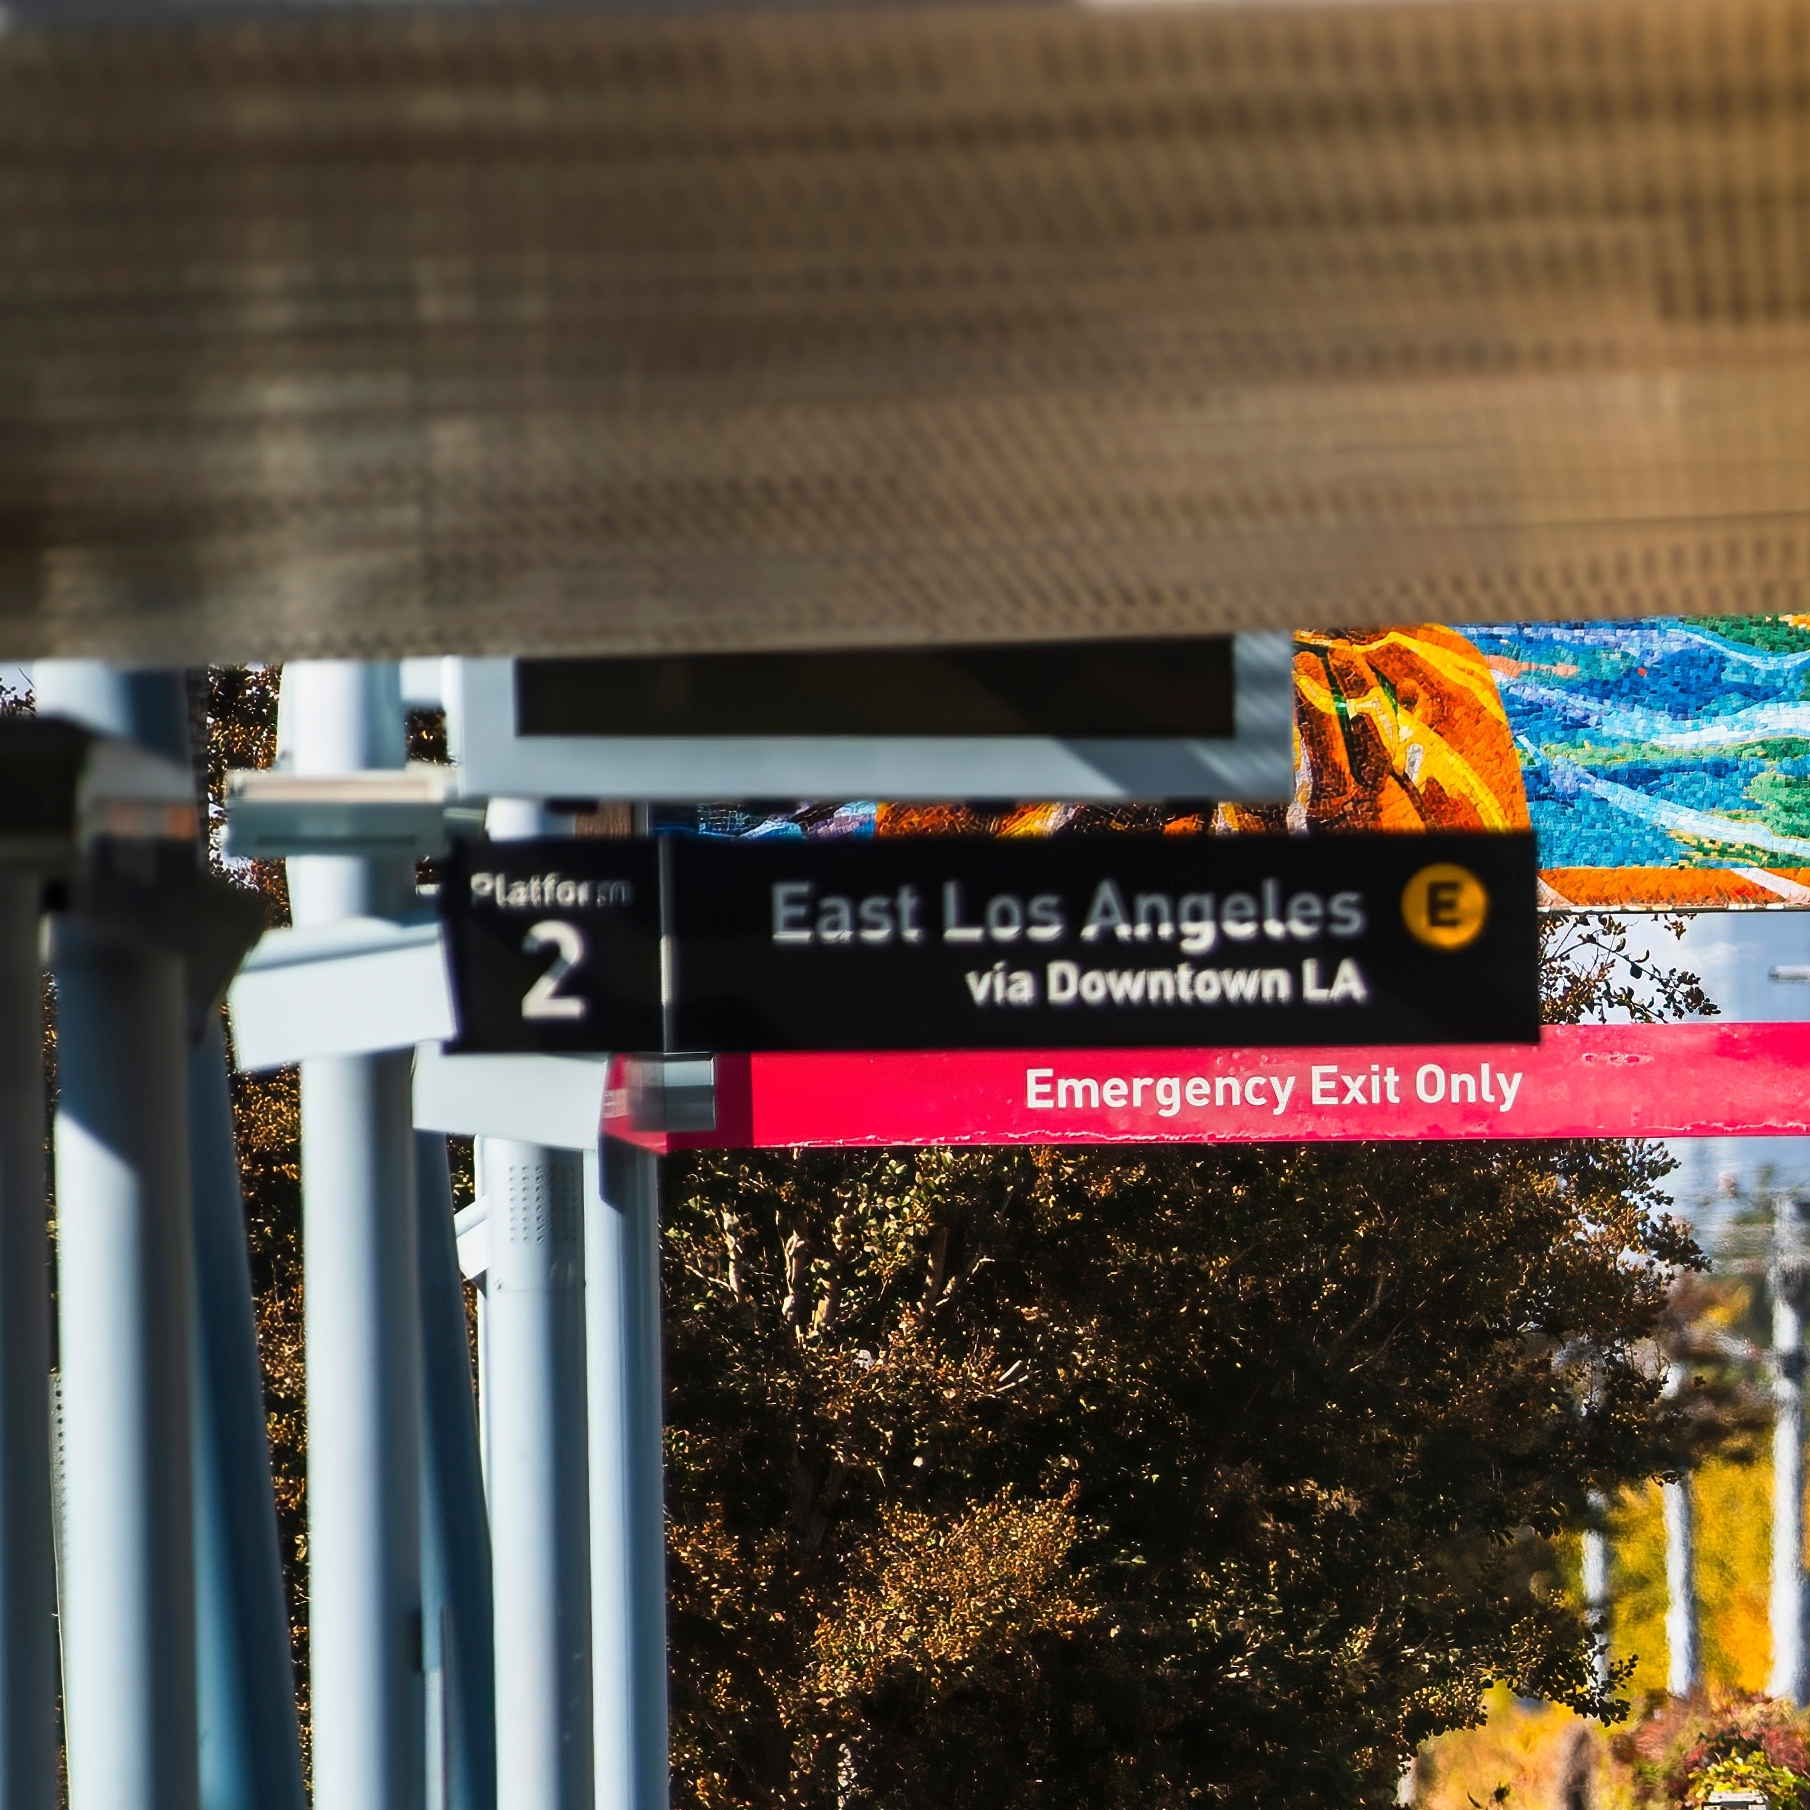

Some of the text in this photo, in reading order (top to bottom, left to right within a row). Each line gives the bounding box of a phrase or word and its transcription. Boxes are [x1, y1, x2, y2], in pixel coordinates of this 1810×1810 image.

[471, 873, 631, 909] Platform
[772, 877, 1367, 955] East Los Angeles
[1426, 881, 1462, 928] E
[521, 919, 585, 1020] 2
[965, 957, 1369, 1006] via Downtown LA
[1025, 1062, 1523, 1117] Emergency Exit Only
